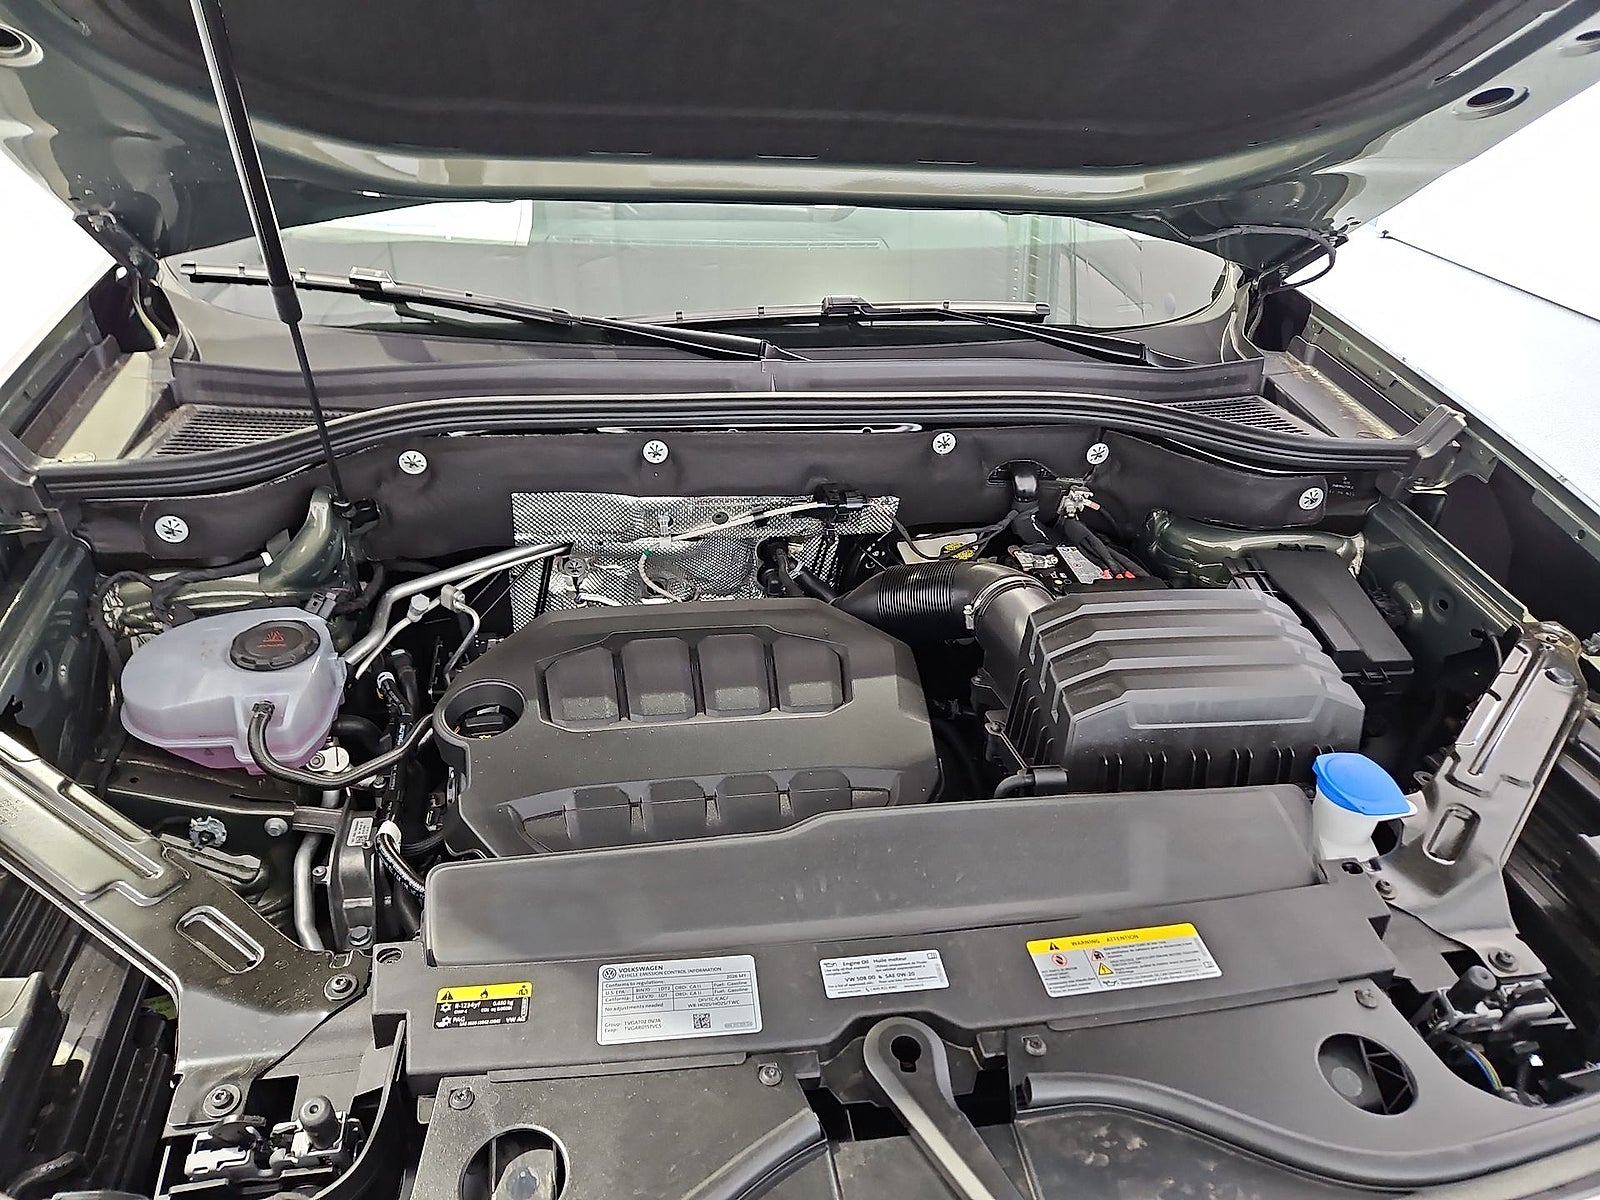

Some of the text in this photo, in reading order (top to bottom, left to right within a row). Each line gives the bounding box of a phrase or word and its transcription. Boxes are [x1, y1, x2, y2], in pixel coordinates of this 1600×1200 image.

[1106, 935, 1139, 943] ATTENTION
[618, 964, 664, 973] VOLKSWAGEN
[454, 1001, 482, 1010] R-1234yf
